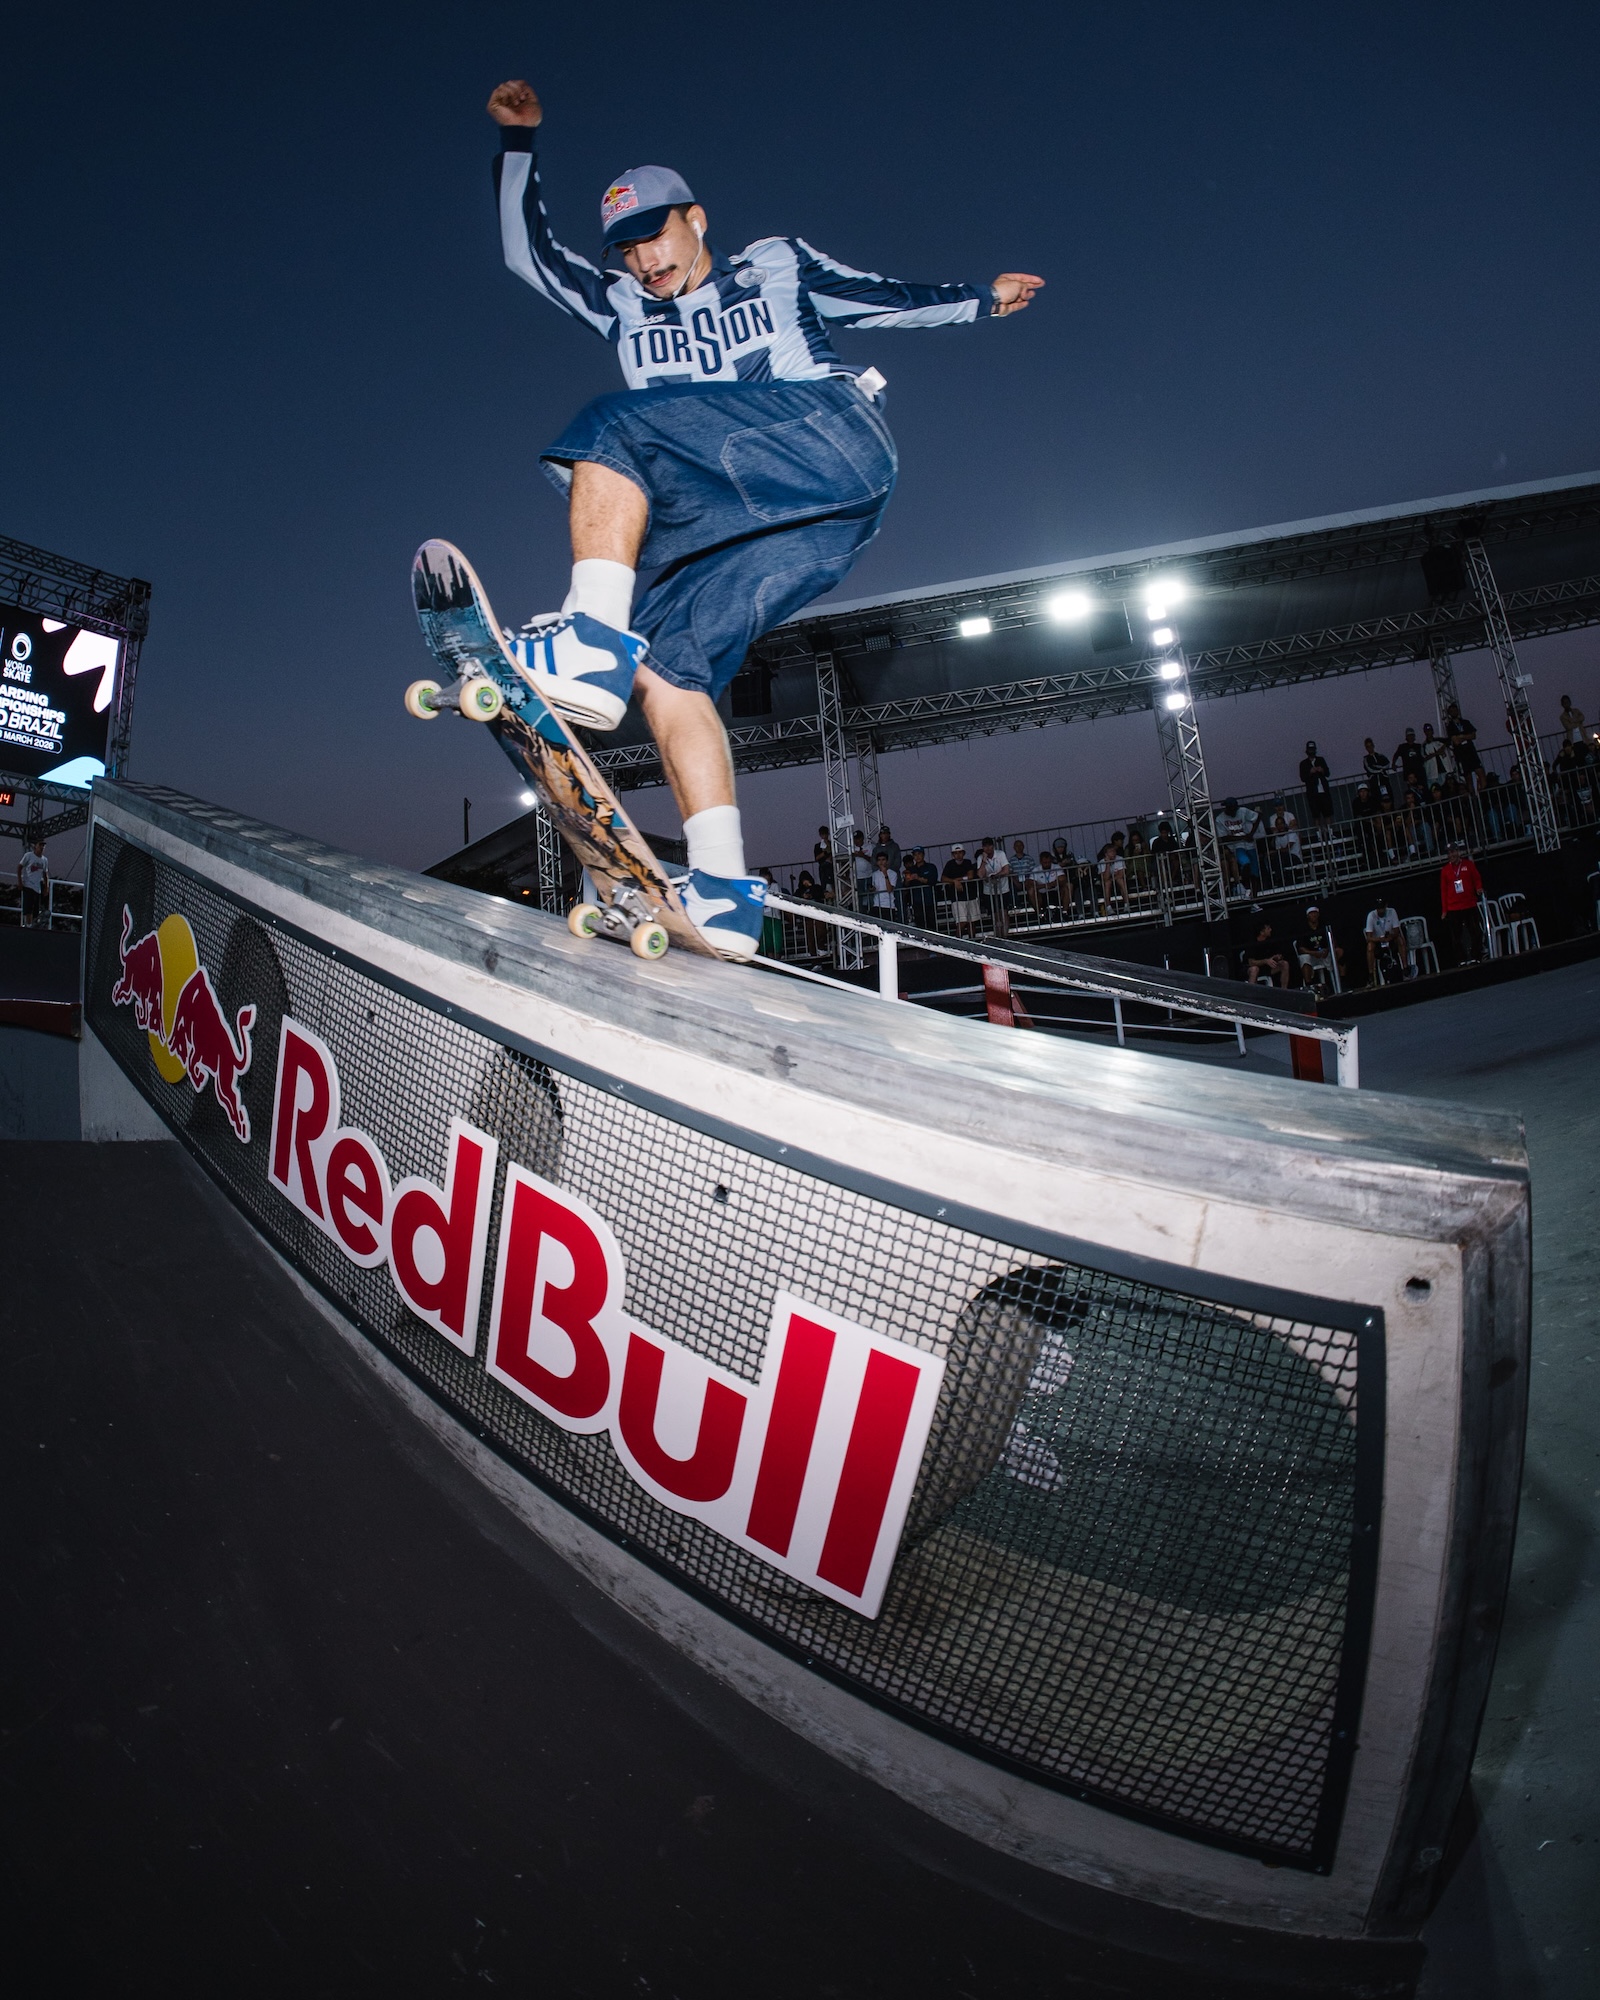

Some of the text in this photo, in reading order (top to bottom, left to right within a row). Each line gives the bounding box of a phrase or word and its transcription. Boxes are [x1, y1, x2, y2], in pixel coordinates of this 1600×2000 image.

[628, 300, 776, 375] TORSION
[3, 667, 31, 683] SKATE
[5, 658, 32, 674] WORLD
[0, 696, 65, 724] PIONSHIPS
[4, 730, 33, 745] MARCH
[8, 712, 63, 740] BRAZIL
[273, 1028, 921, 1598] Red Bull
